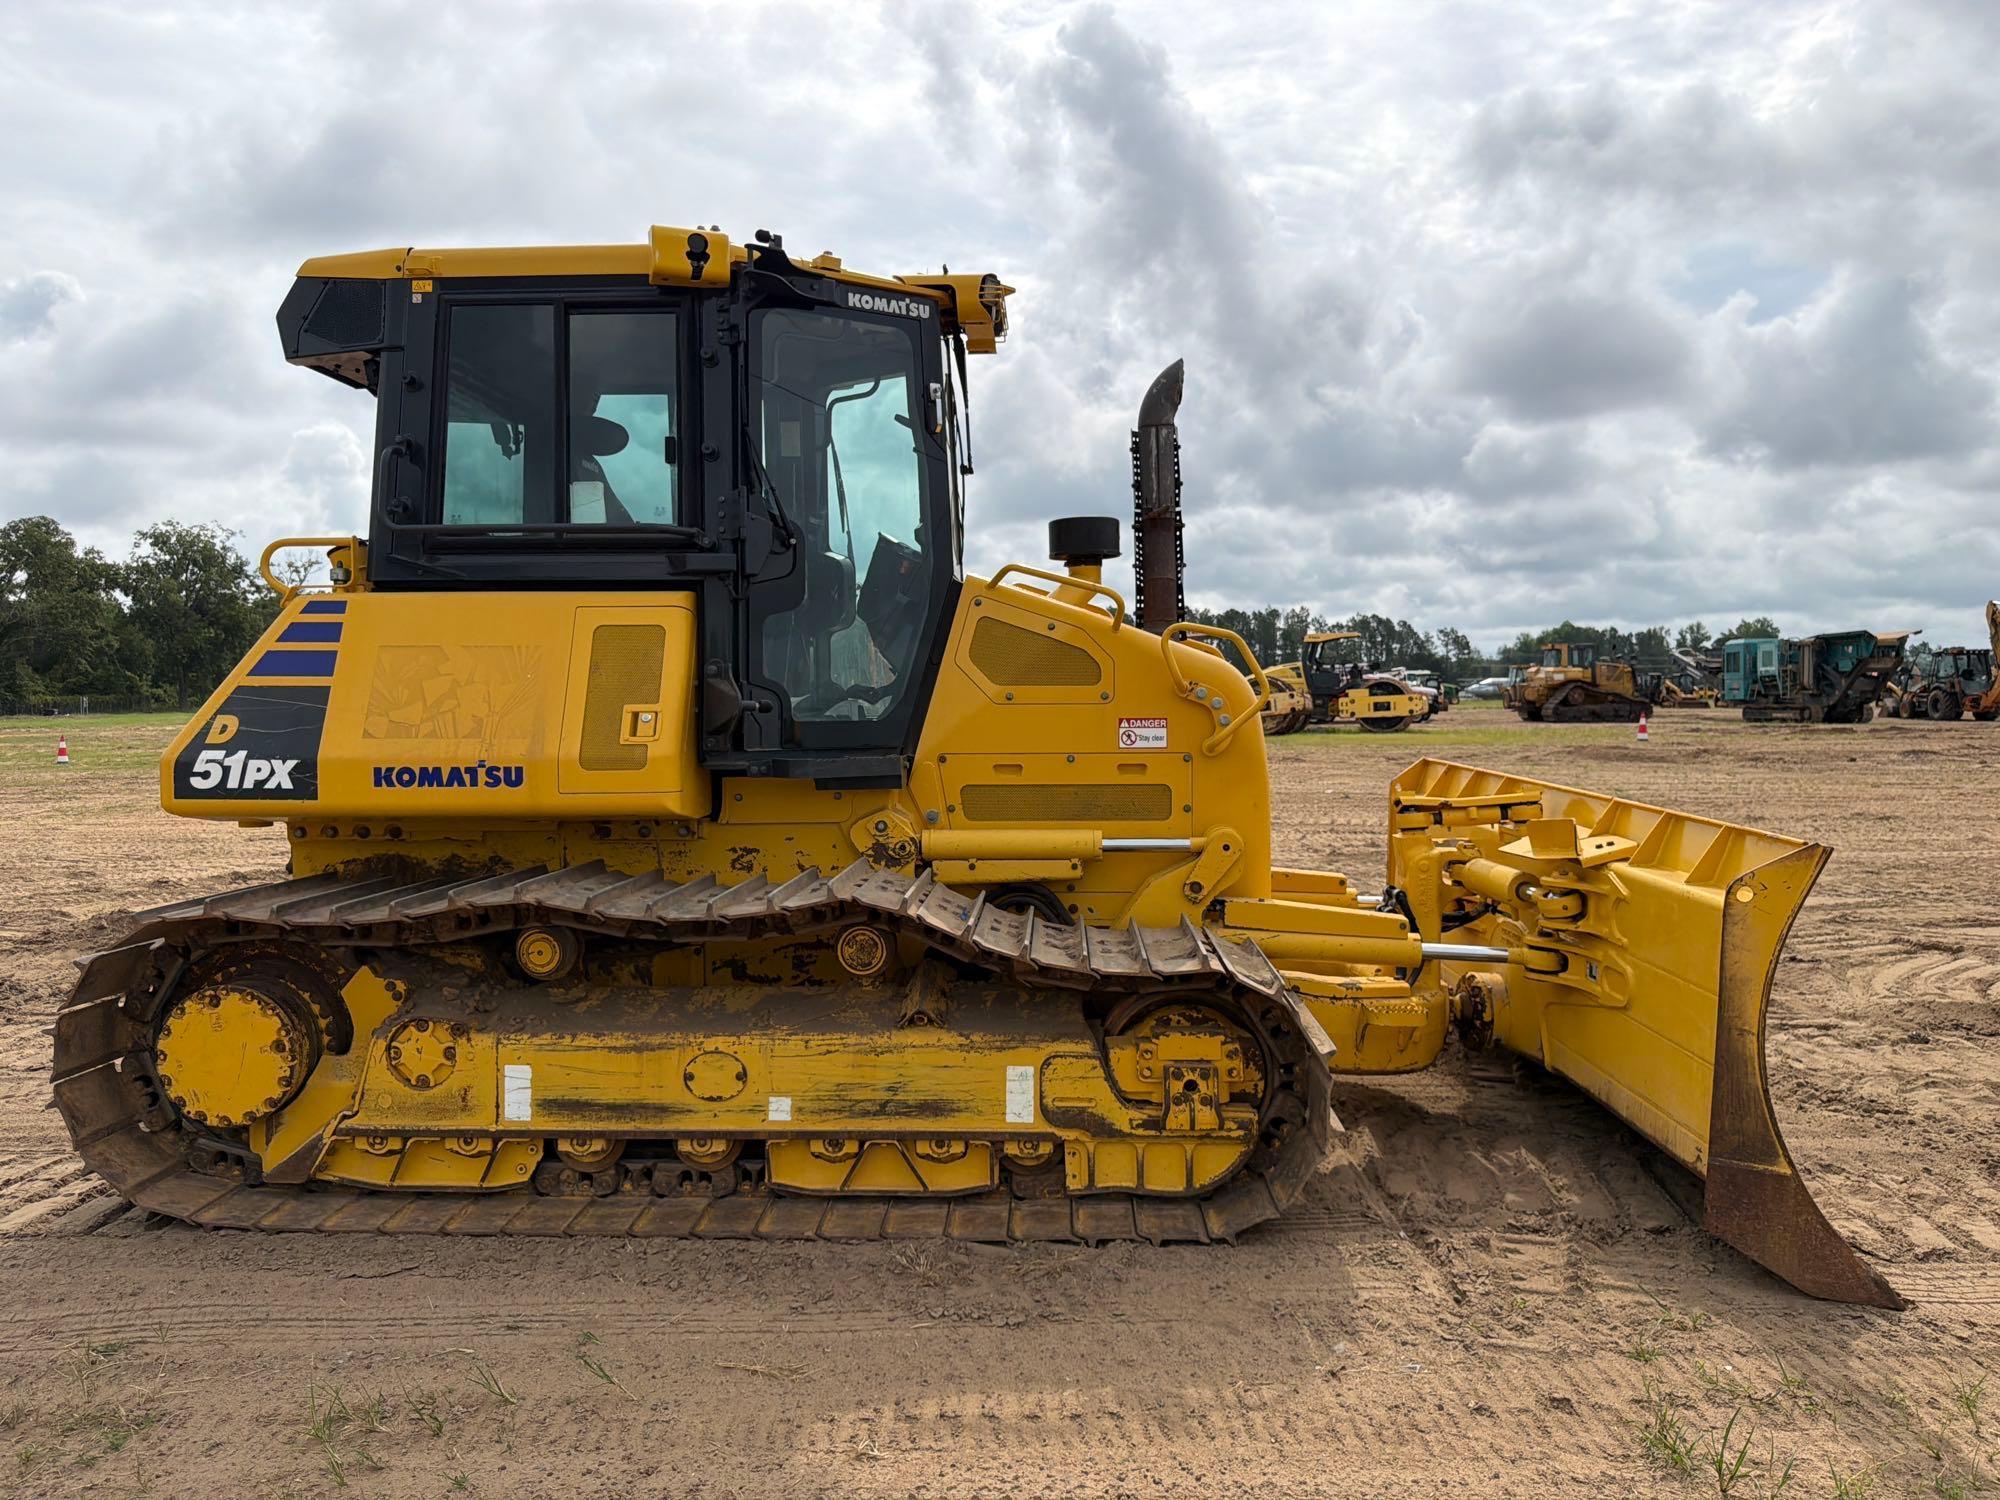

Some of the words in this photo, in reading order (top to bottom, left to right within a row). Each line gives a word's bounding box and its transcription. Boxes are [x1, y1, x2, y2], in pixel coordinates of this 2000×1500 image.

[847, 292, 930, 319] KOMATSU
[205, 714, 239, 744] D
[1129, 719, 1167, 728] DANGER
[1138, 735, 1151, 743] Stay
[1151, 733, 1165, 742] clear
[189, 749, 301, 790] 51PX
[373, 760, 524, 788] KOMATSU
